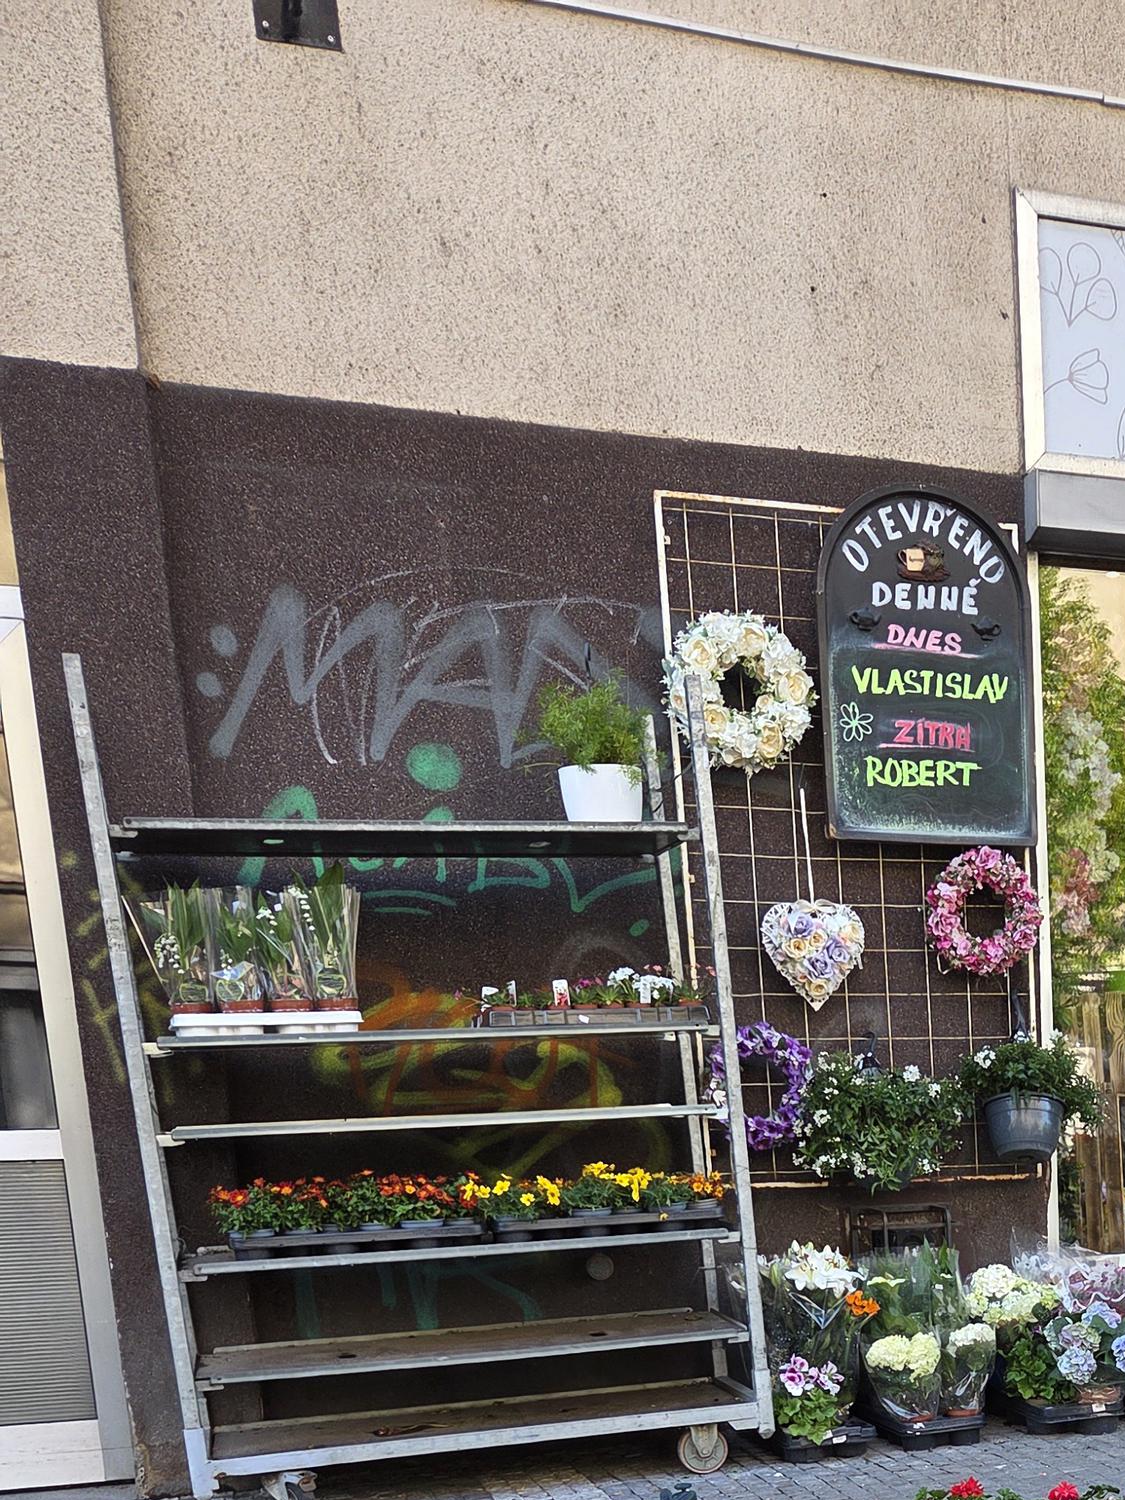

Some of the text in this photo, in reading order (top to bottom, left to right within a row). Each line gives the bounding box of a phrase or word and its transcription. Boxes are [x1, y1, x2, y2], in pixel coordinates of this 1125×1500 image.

[842, 500, 1005, 584] OTEVŘENO
[871, 578, 982, 615] DENNĚ
[887, 623, 962, 654] DNES
[851, 665, 1009, 703] VLASTISLAV
[864, 756, 983, 787] ROBERT
